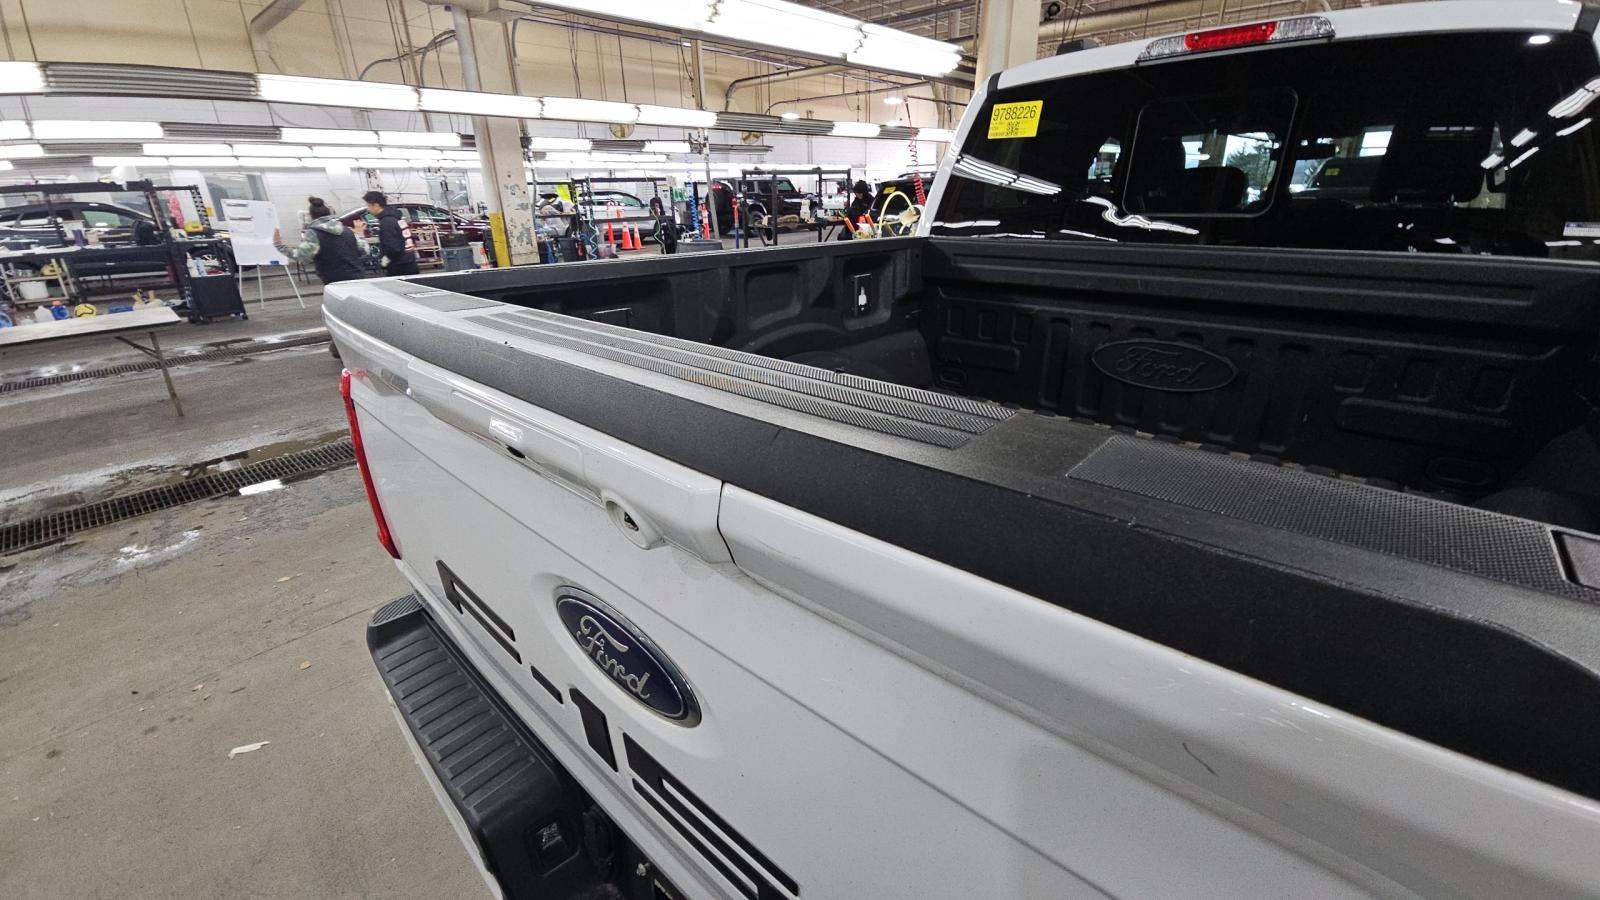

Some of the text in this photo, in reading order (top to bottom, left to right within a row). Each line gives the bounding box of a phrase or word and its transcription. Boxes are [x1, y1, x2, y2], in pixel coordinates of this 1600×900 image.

[993, 105, 1037, 121] 9788226
[1116, 346, 1206, 383] Ford
[577, 615, 650, 699] Ford
